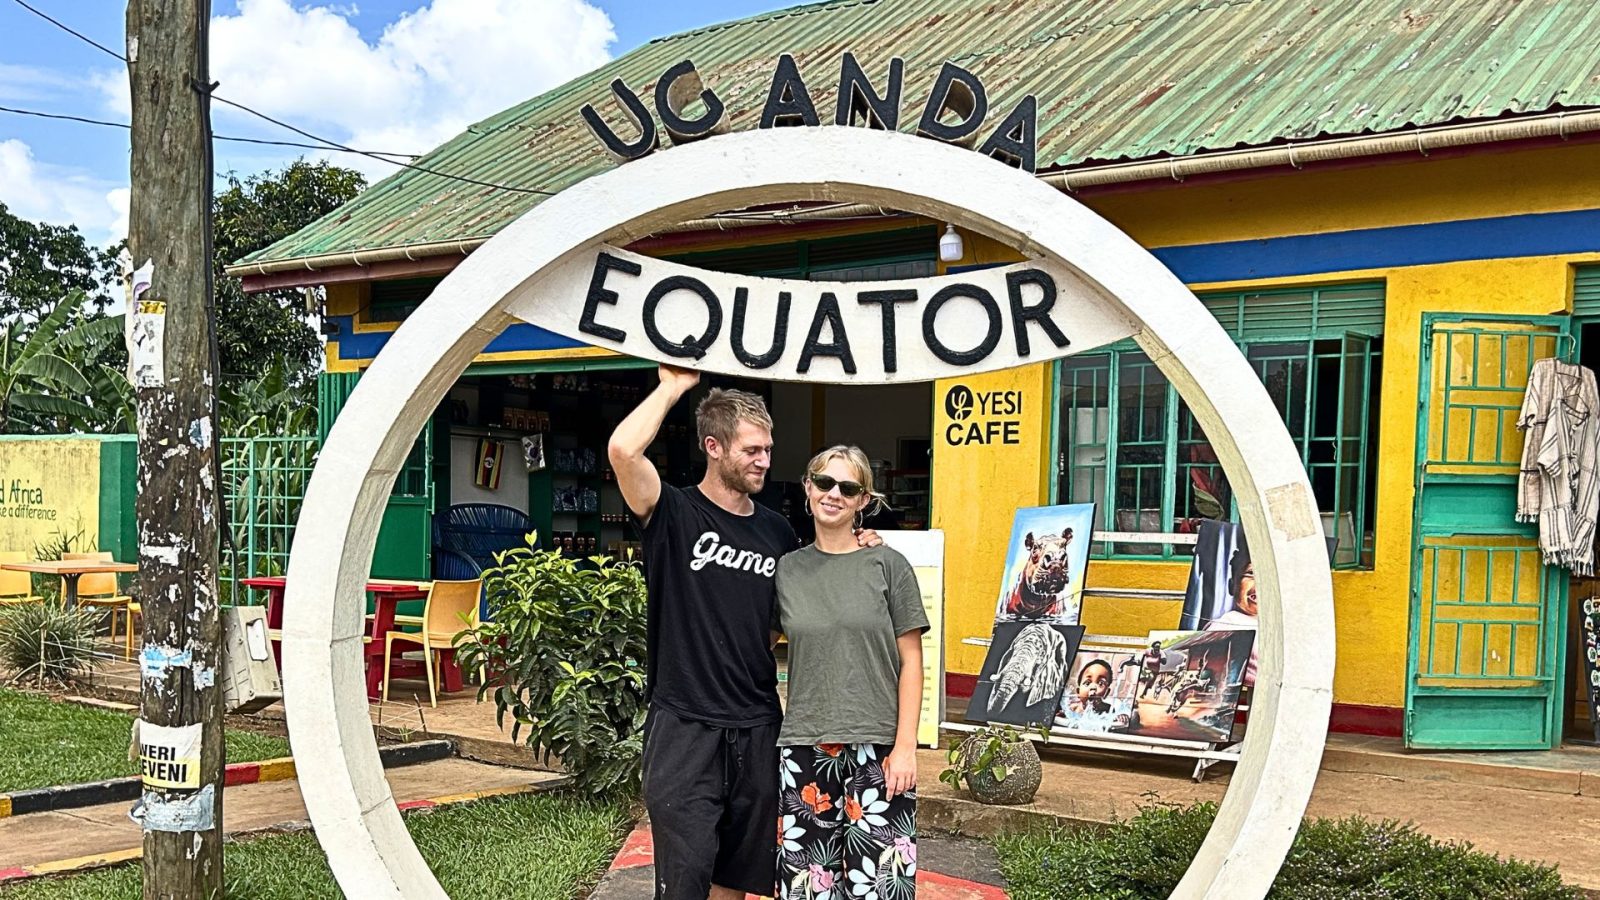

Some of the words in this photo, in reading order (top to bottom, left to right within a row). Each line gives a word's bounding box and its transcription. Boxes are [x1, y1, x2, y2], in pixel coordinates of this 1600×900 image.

[580, 52, 1038, 174] UGANDA
[579, 251, 1072, 375] EQUATOR
[976, 390, 1022, 416] YESI
[945, 421, 1020, 446] CAFE
[9, 478, 43, 505] Africa
[8, 507, 14, 518] a
[15, 504, 57, 521] difference
[690, 531, 776, 578] Game
